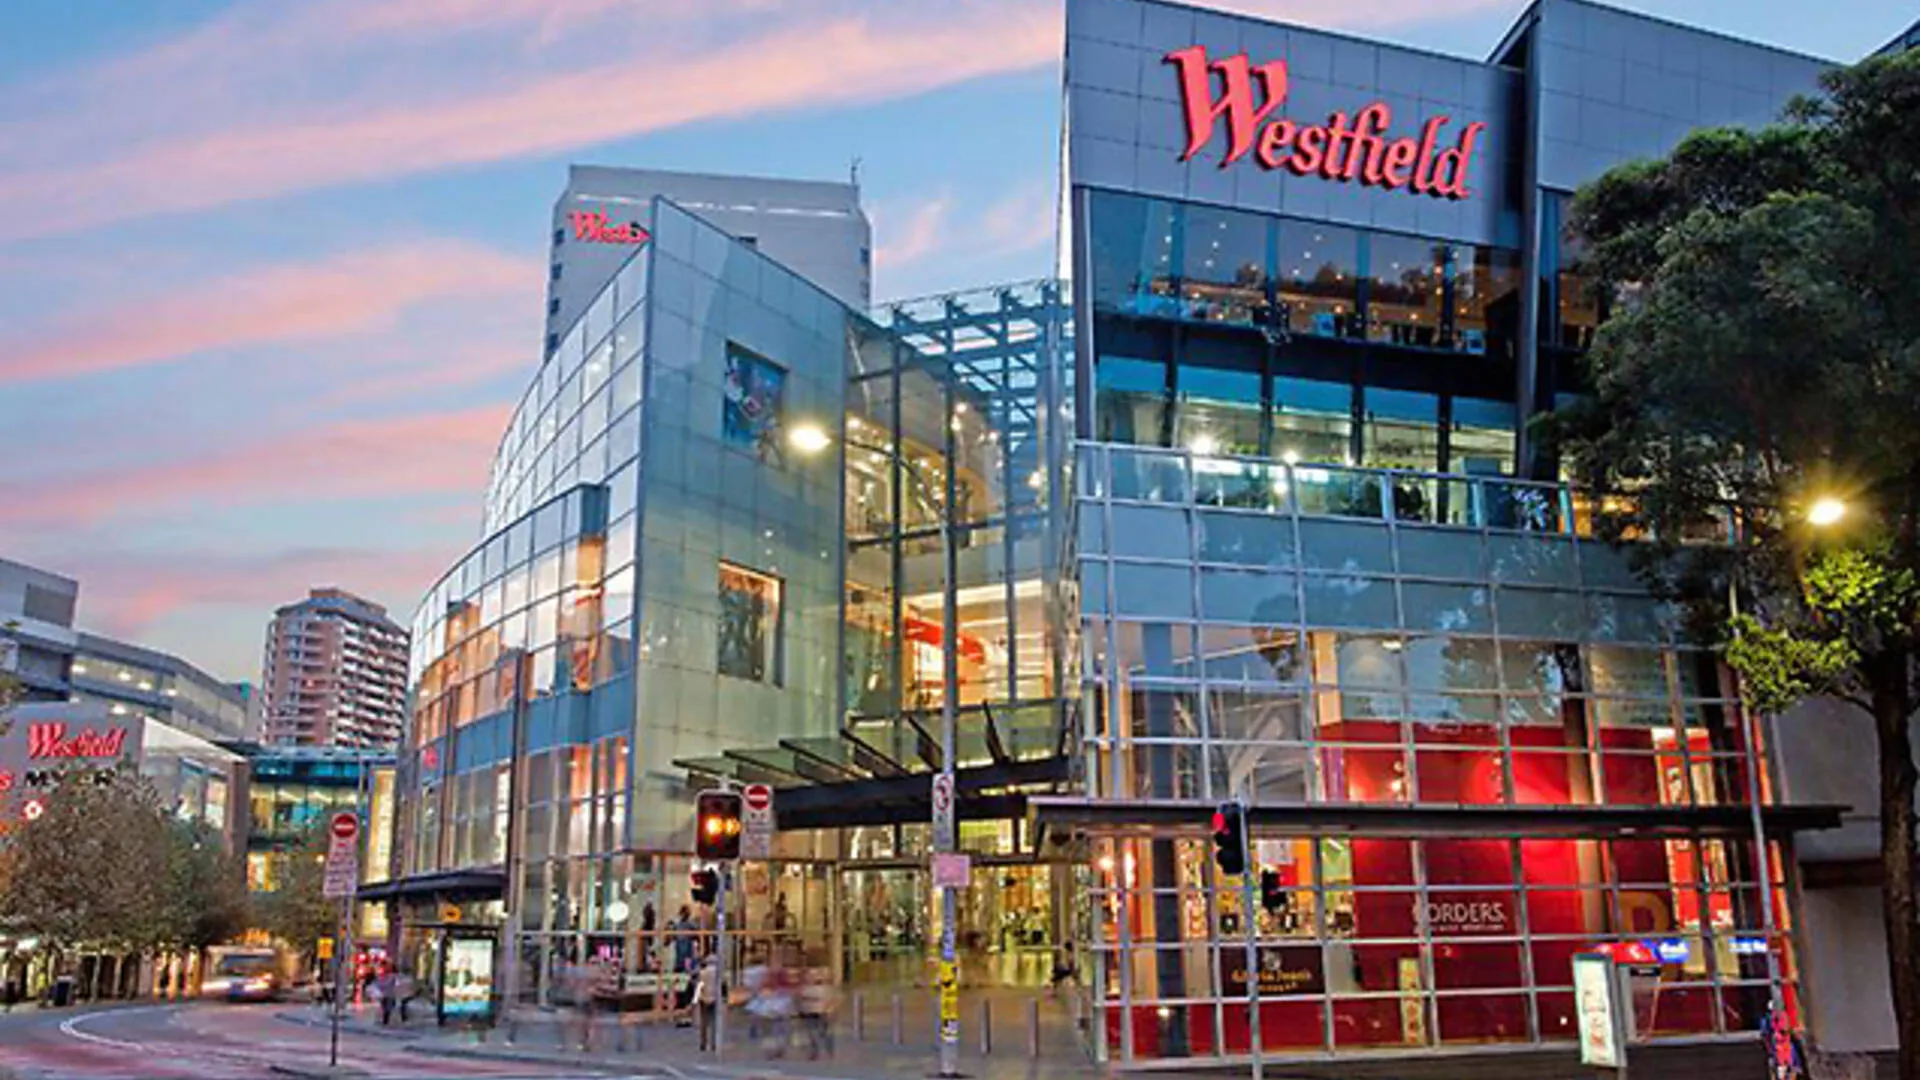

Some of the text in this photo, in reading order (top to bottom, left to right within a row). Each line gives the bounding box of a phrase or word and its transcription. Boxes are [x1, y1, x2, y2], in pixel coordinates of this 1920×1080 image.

[1161, 45, 1487, 200] Westfield
[27, 721, 127, 760] Westfield
[25, 771, 116, 786] MYR
